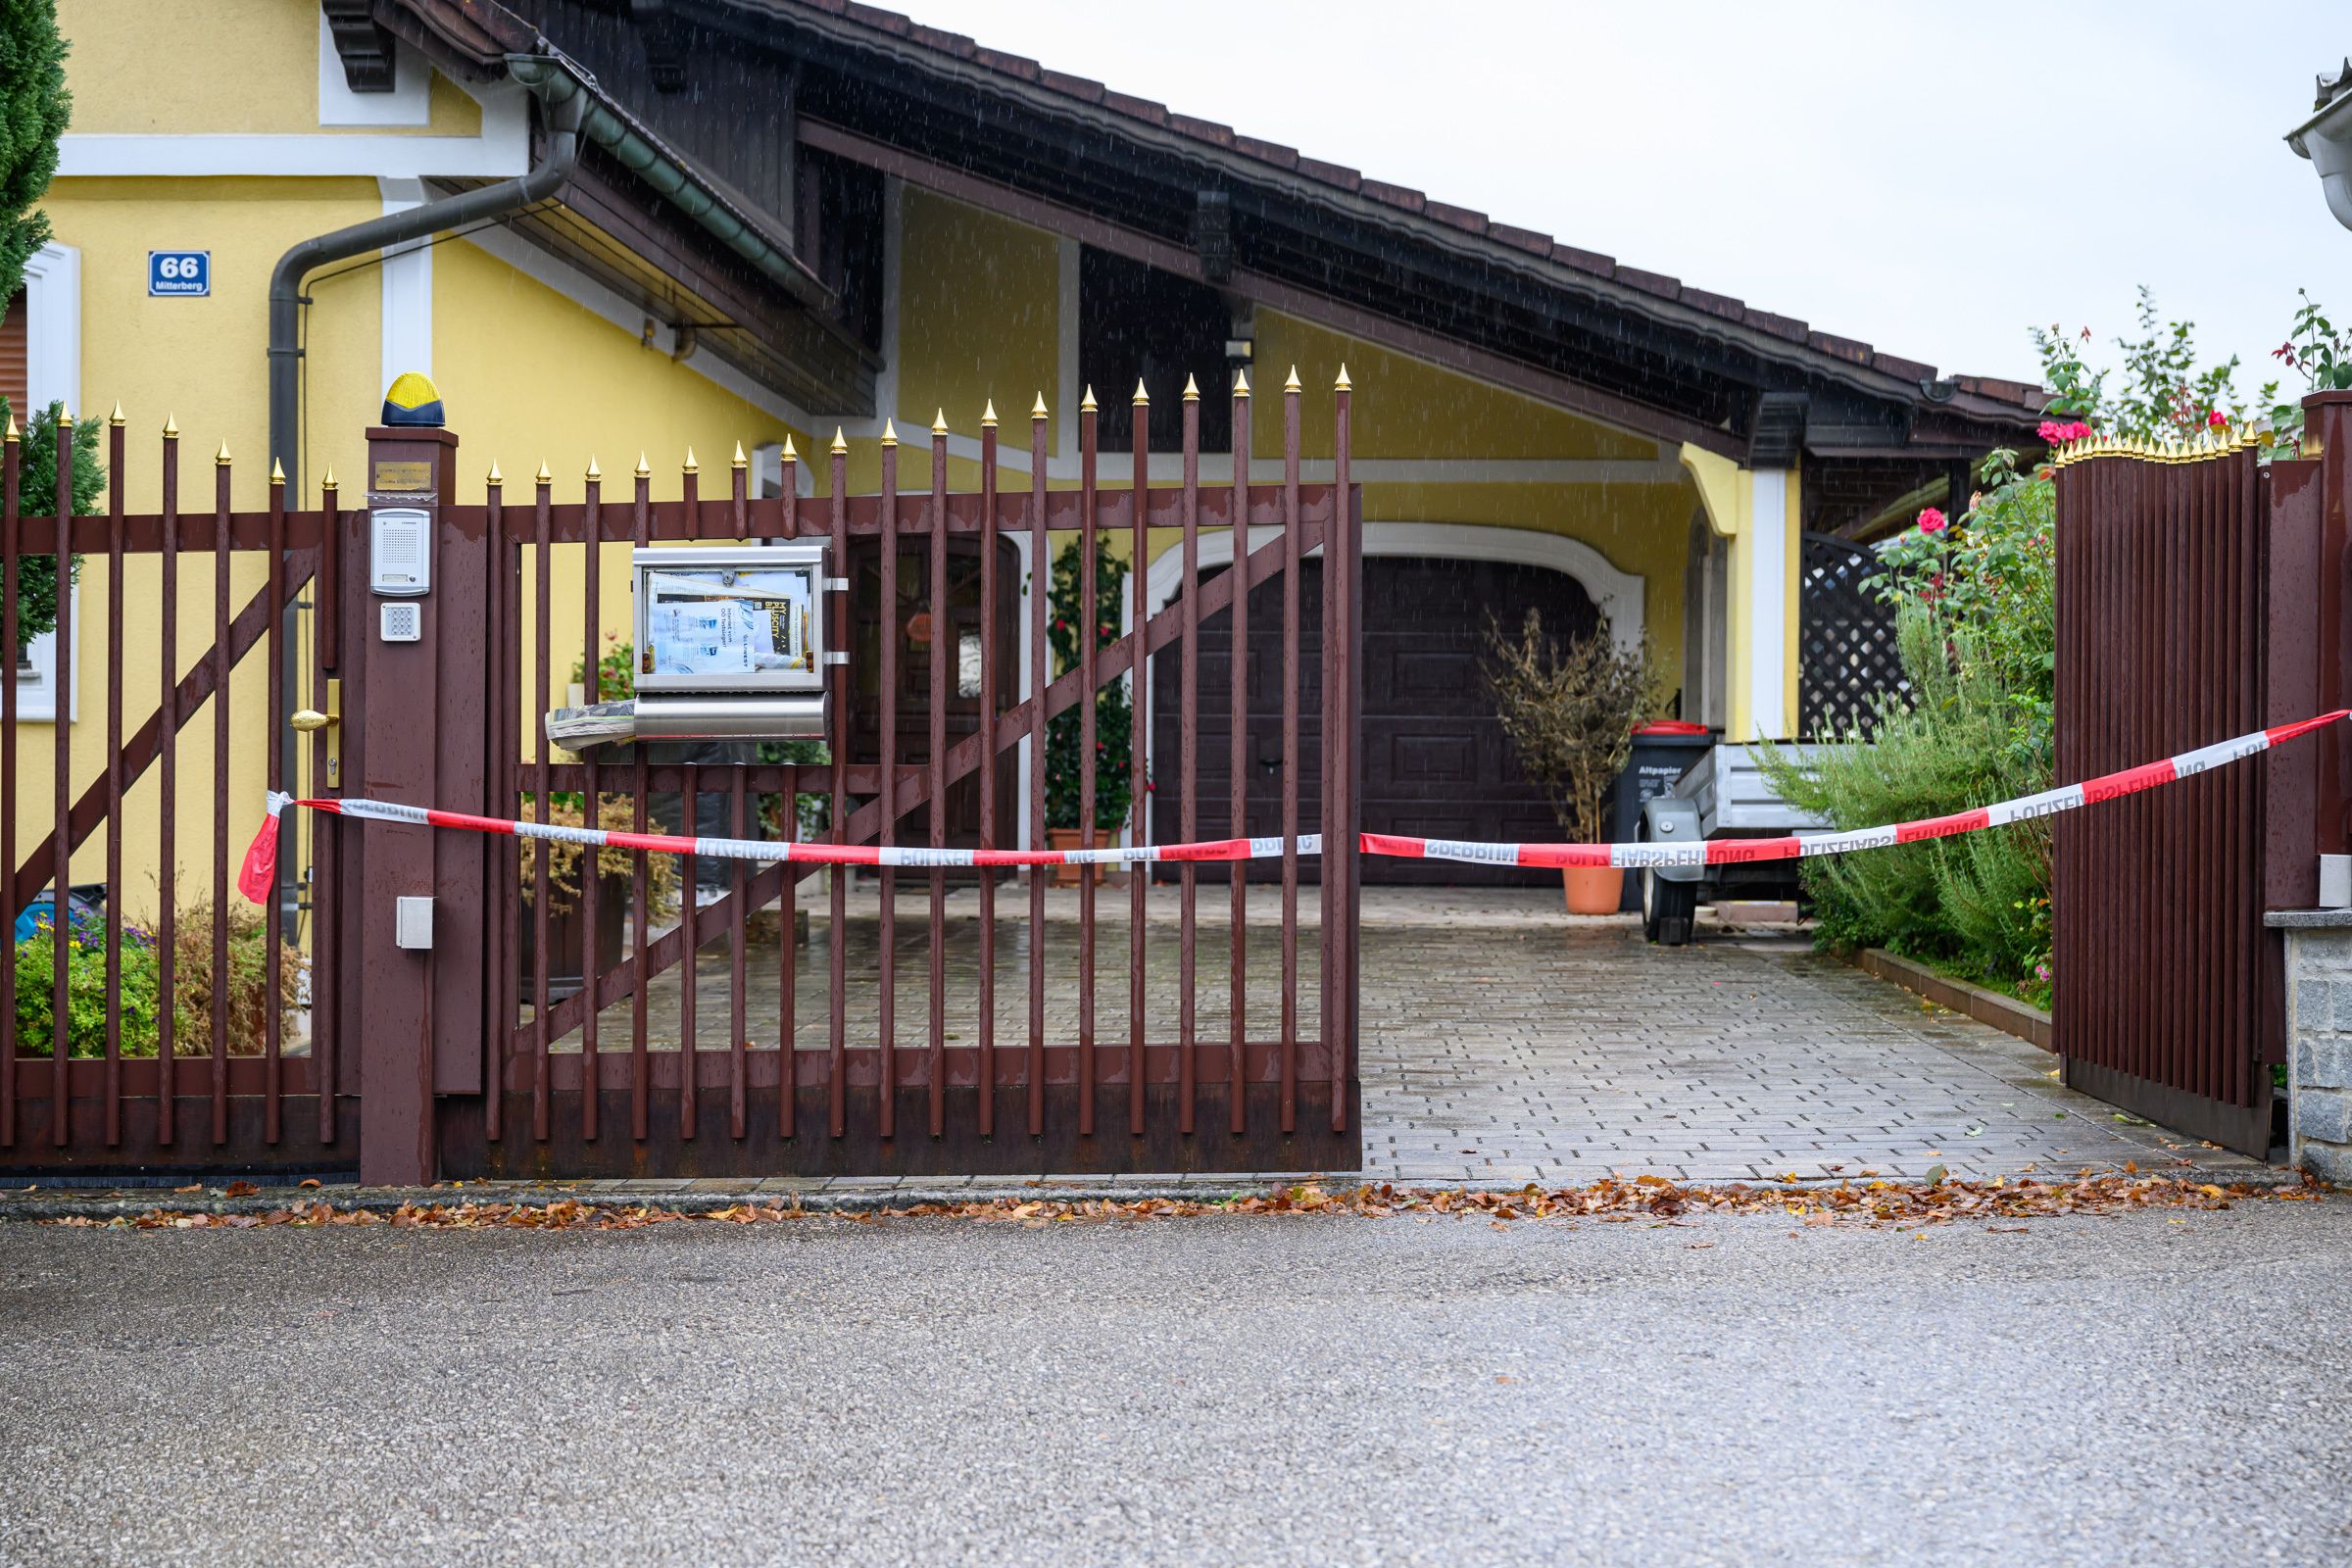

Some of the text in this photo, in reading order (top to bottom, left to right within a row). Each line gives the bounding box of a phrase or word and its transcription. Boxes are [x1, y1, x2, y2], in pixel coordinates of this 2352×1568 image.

[160, 257, 199, 279] 66
[155, 280, 203, 292] Mitterberg
[779, 601, 787, 614] MY
[771, 601, 780, 639] PLUSCITY
[1639, 765, 1683, 776] Altpapier
